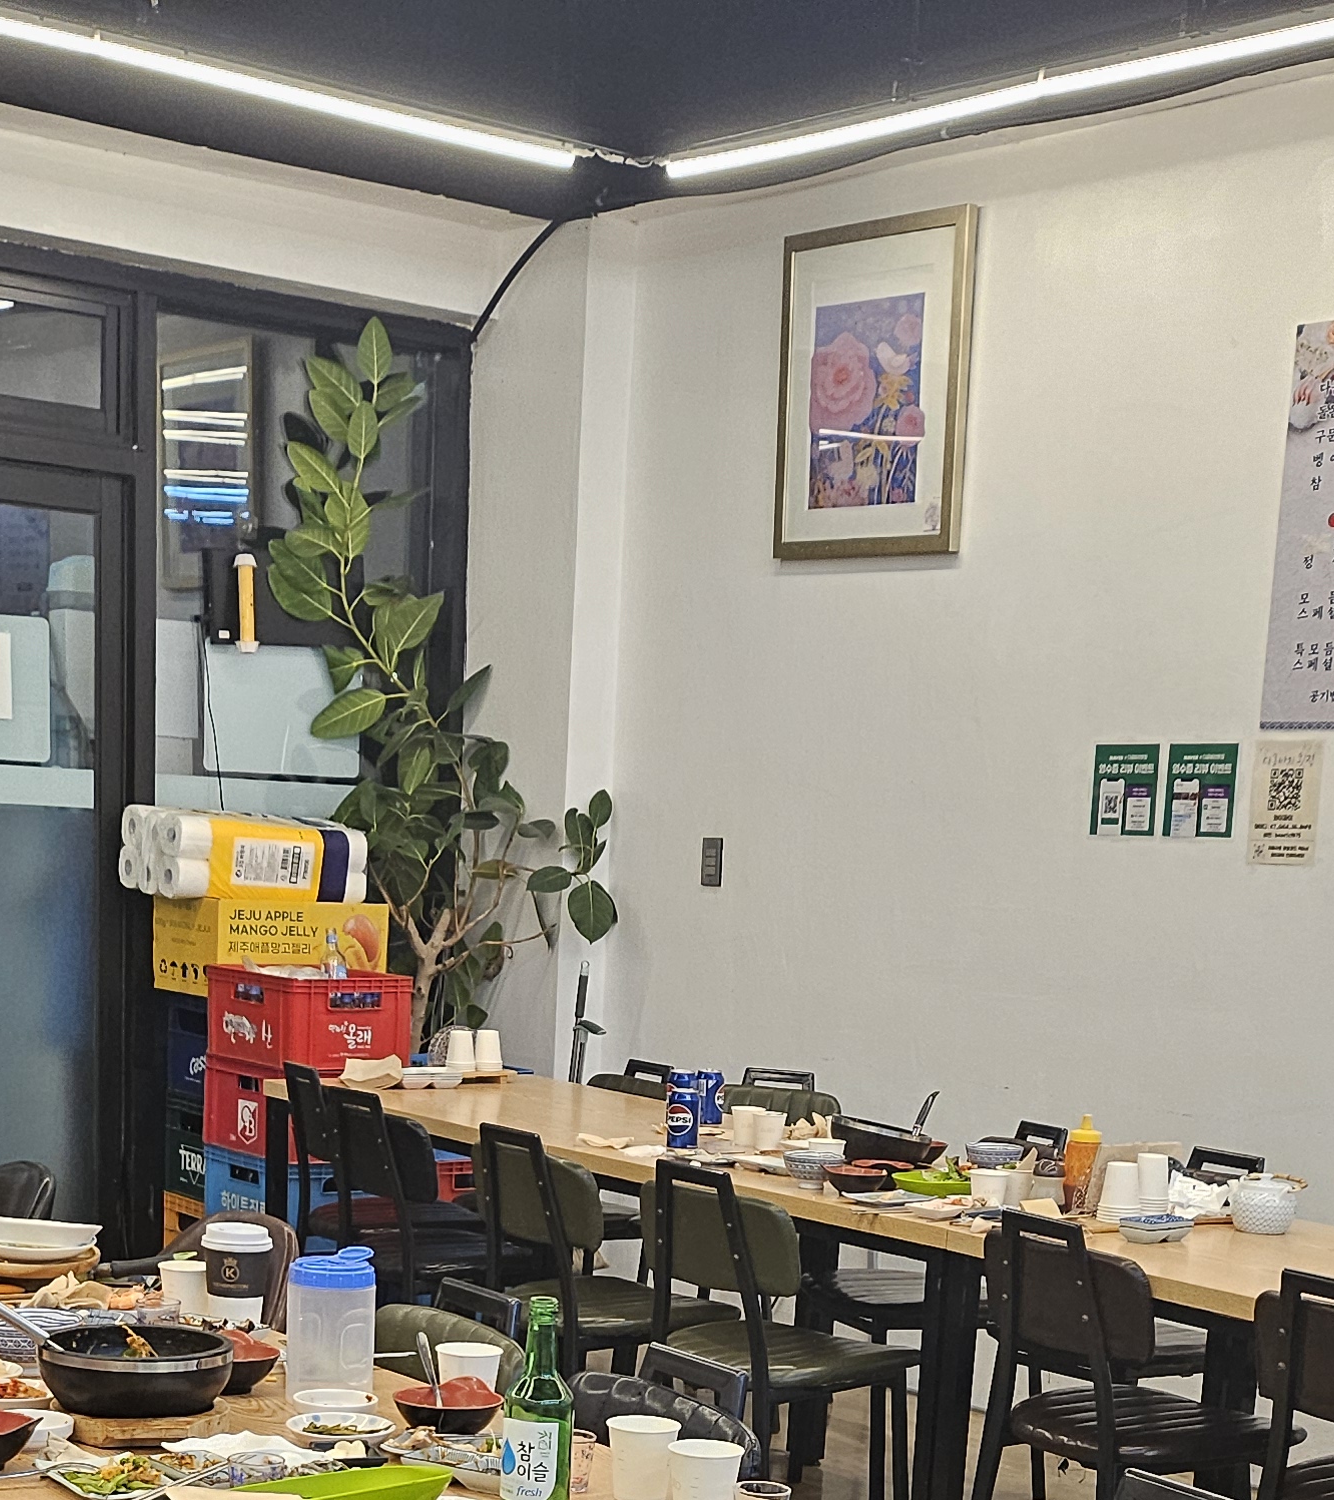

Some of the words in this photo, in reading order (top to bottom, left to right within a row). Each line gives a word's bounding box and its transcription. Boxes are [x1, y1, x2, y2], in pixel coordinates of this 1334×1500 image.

[229, 909, 262, 922] JEJU
[264, 910, 305, 923] APPLE
[229, 923, 279, 937] MANGO
[280, 925, 319, 938] JELLY
[228, 940, 312, 955] 제주애플망고젤리
[225, 1267, 236, 1279] K
[516, 1440, 536, 1462] 참
[516, 1462, 550, 1483] 이슬
[515, 1485, 543, 1498] fresh
